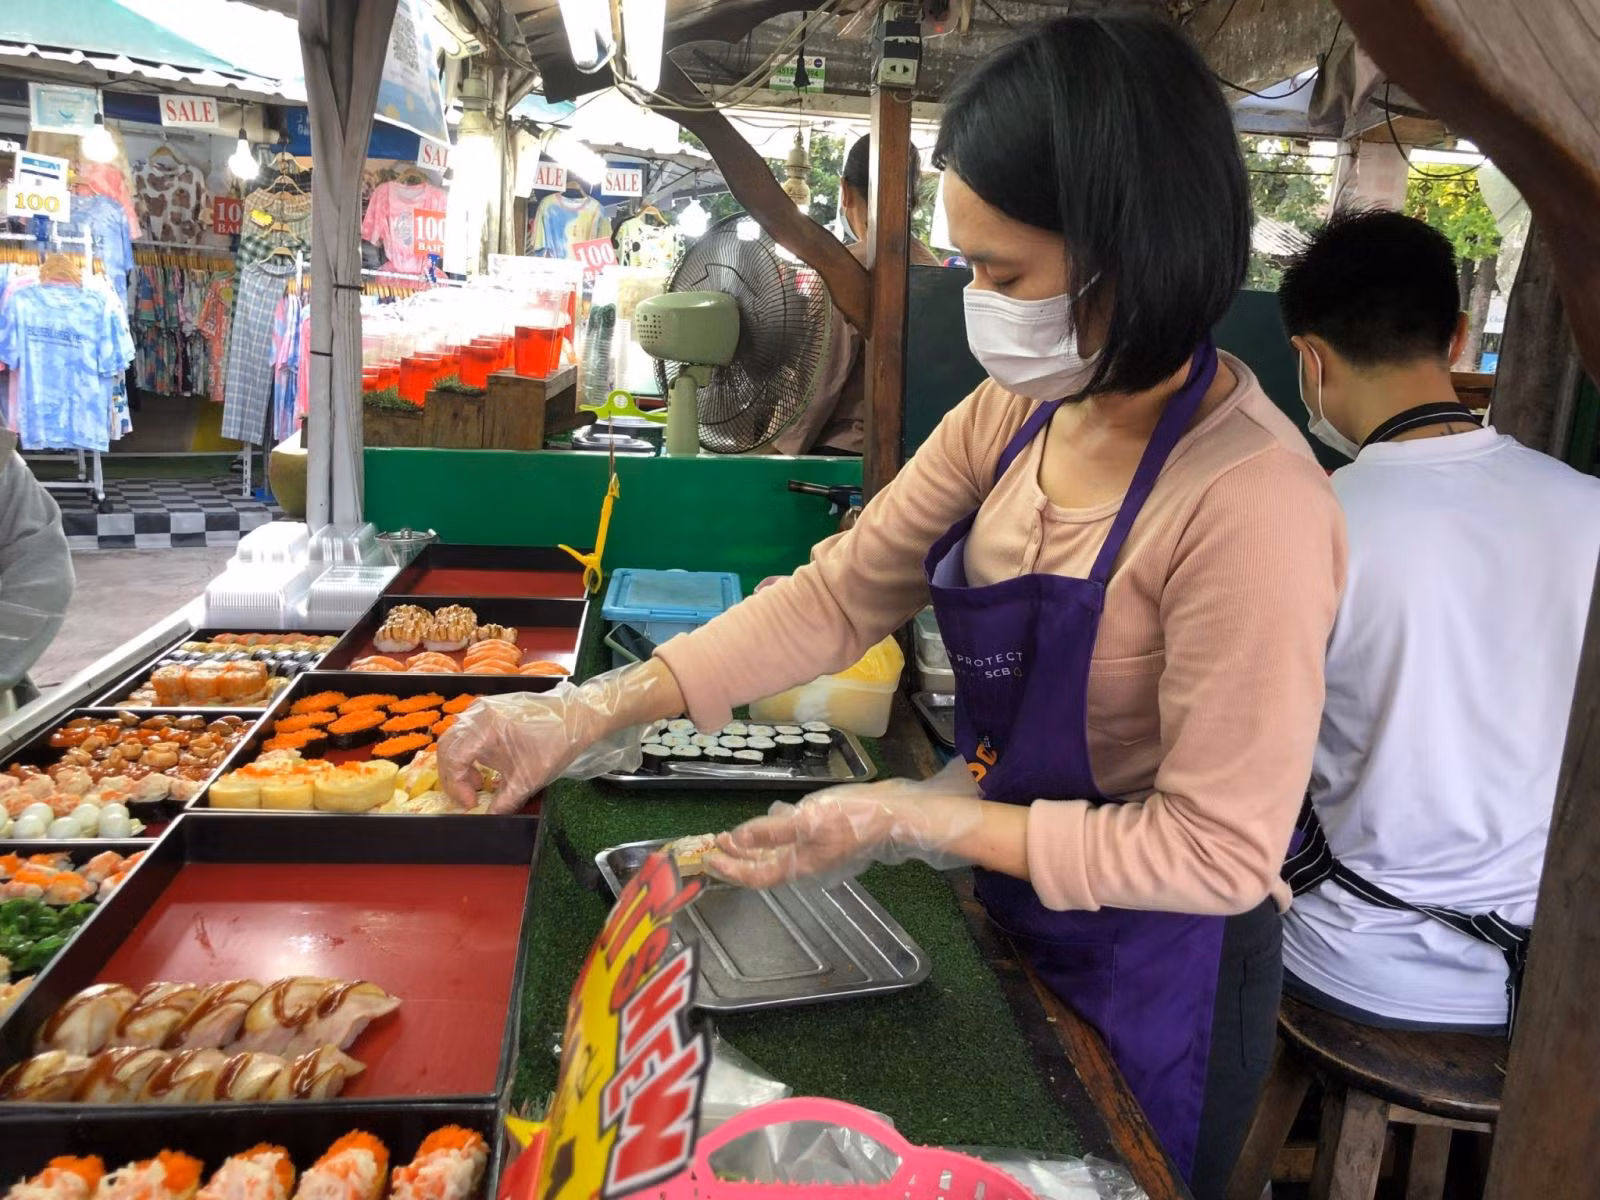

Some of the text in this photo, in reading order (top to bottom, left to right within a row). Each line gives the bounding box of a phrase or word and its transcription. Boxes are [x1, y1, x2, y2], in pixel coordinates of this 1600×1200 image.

[166, 99, 215, 123] SALE
[423, 143, 449, 168] SAL
[535, 166, 564, 187] ALE
[605, 172, 639, 193] SALE
[14, 192, 60, 213] 100
[217, 202, 242, 223] 10
[575, 242, 616, 268] 100
[956, 651, 1023, 667] PROTECT
[984, 667, 1011, 679] SCB
[602, 946, 705, 1197] NEW
